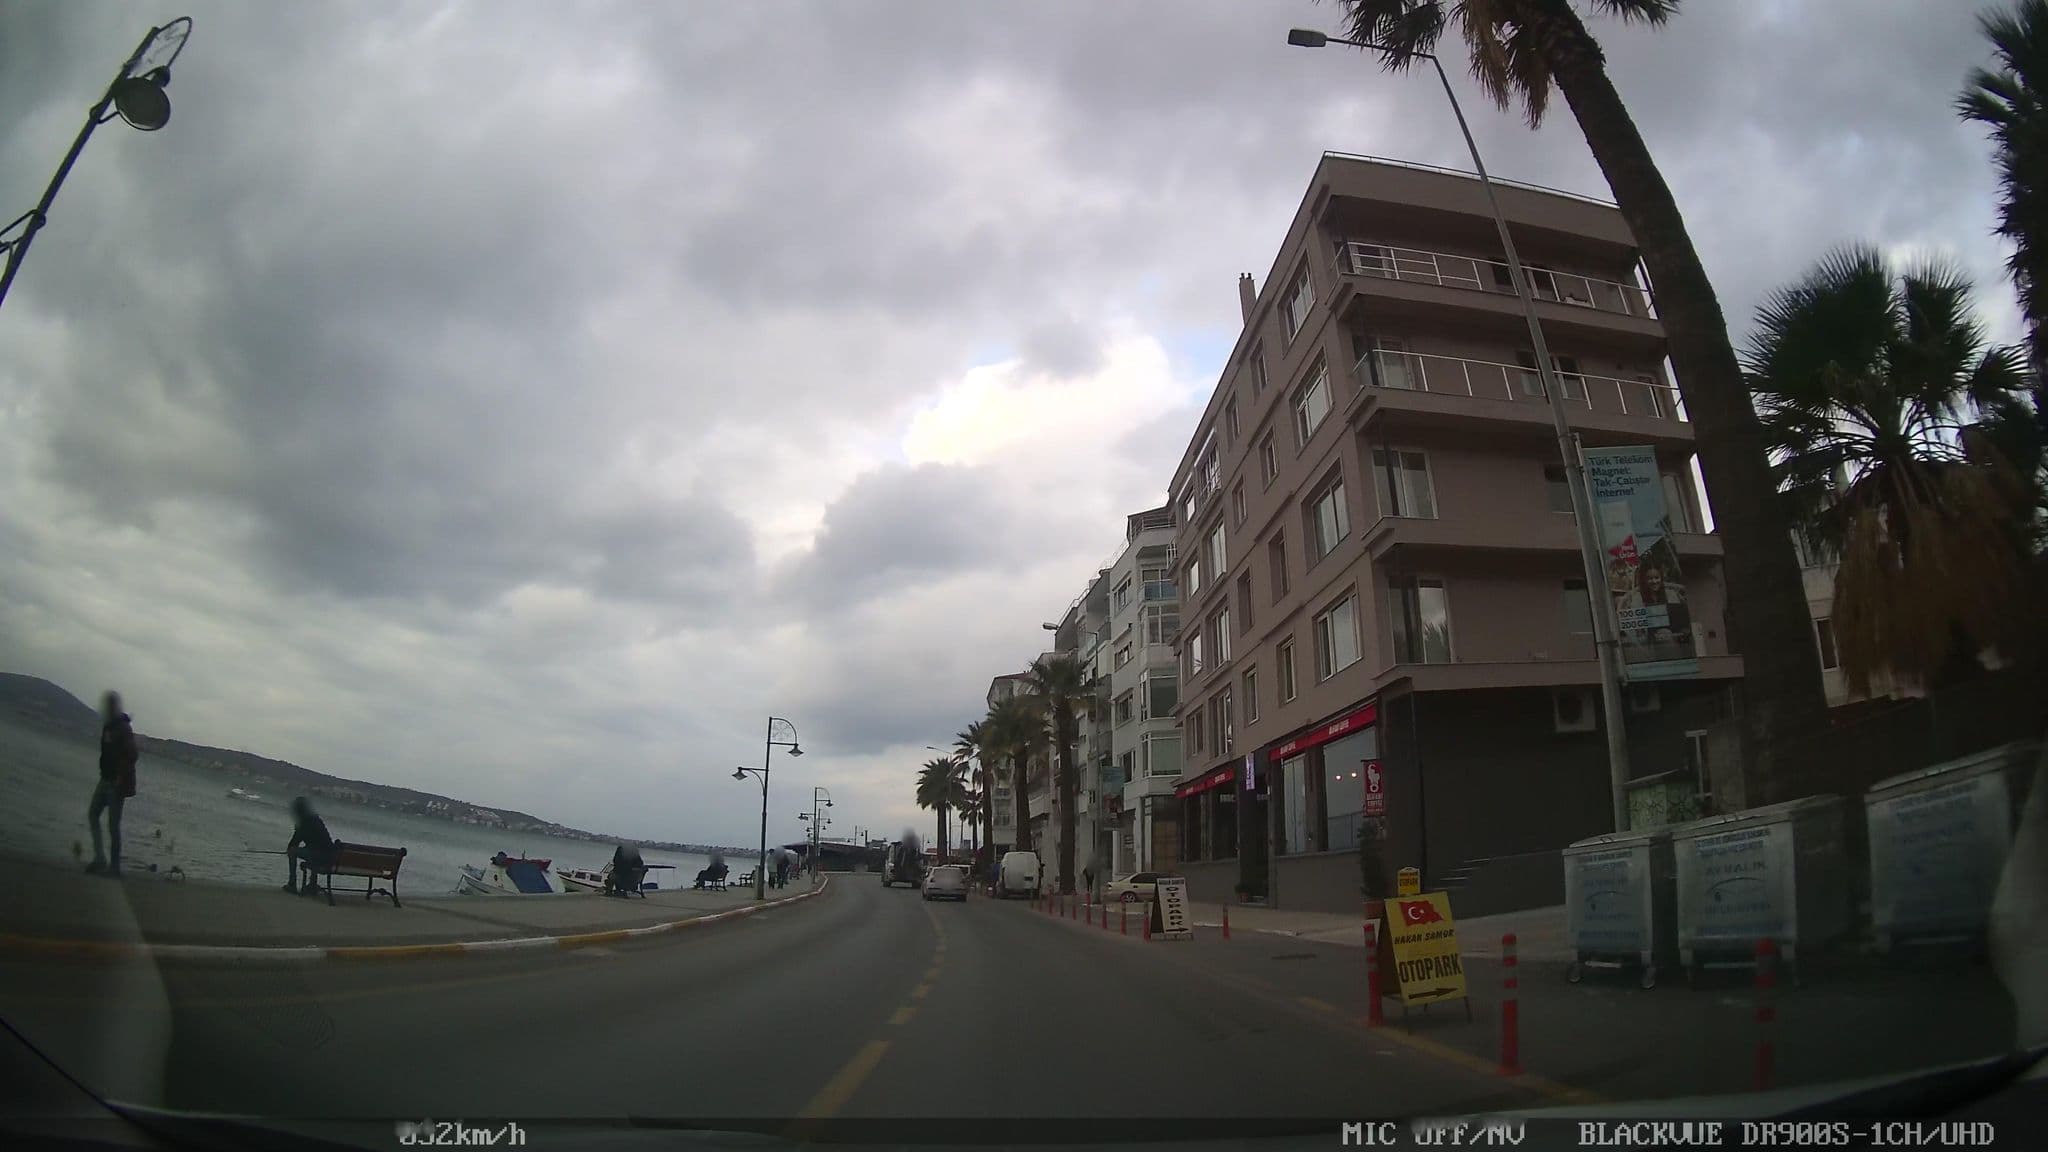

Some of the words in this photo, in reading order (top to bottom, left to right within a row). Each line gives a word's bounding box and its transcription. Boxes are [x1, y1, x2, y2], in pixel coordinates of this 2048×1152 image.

[1619, 609, 1634, 618] 100
[1635, 608, 1647, 616] GB
[1621, 621, 1637, 629] 200
[1166, 886, 1183, 926] OTOPARK
[1394, 933, 1423, 945] HAKAN
[1399, 953, 1462, 983] OTOPARK
